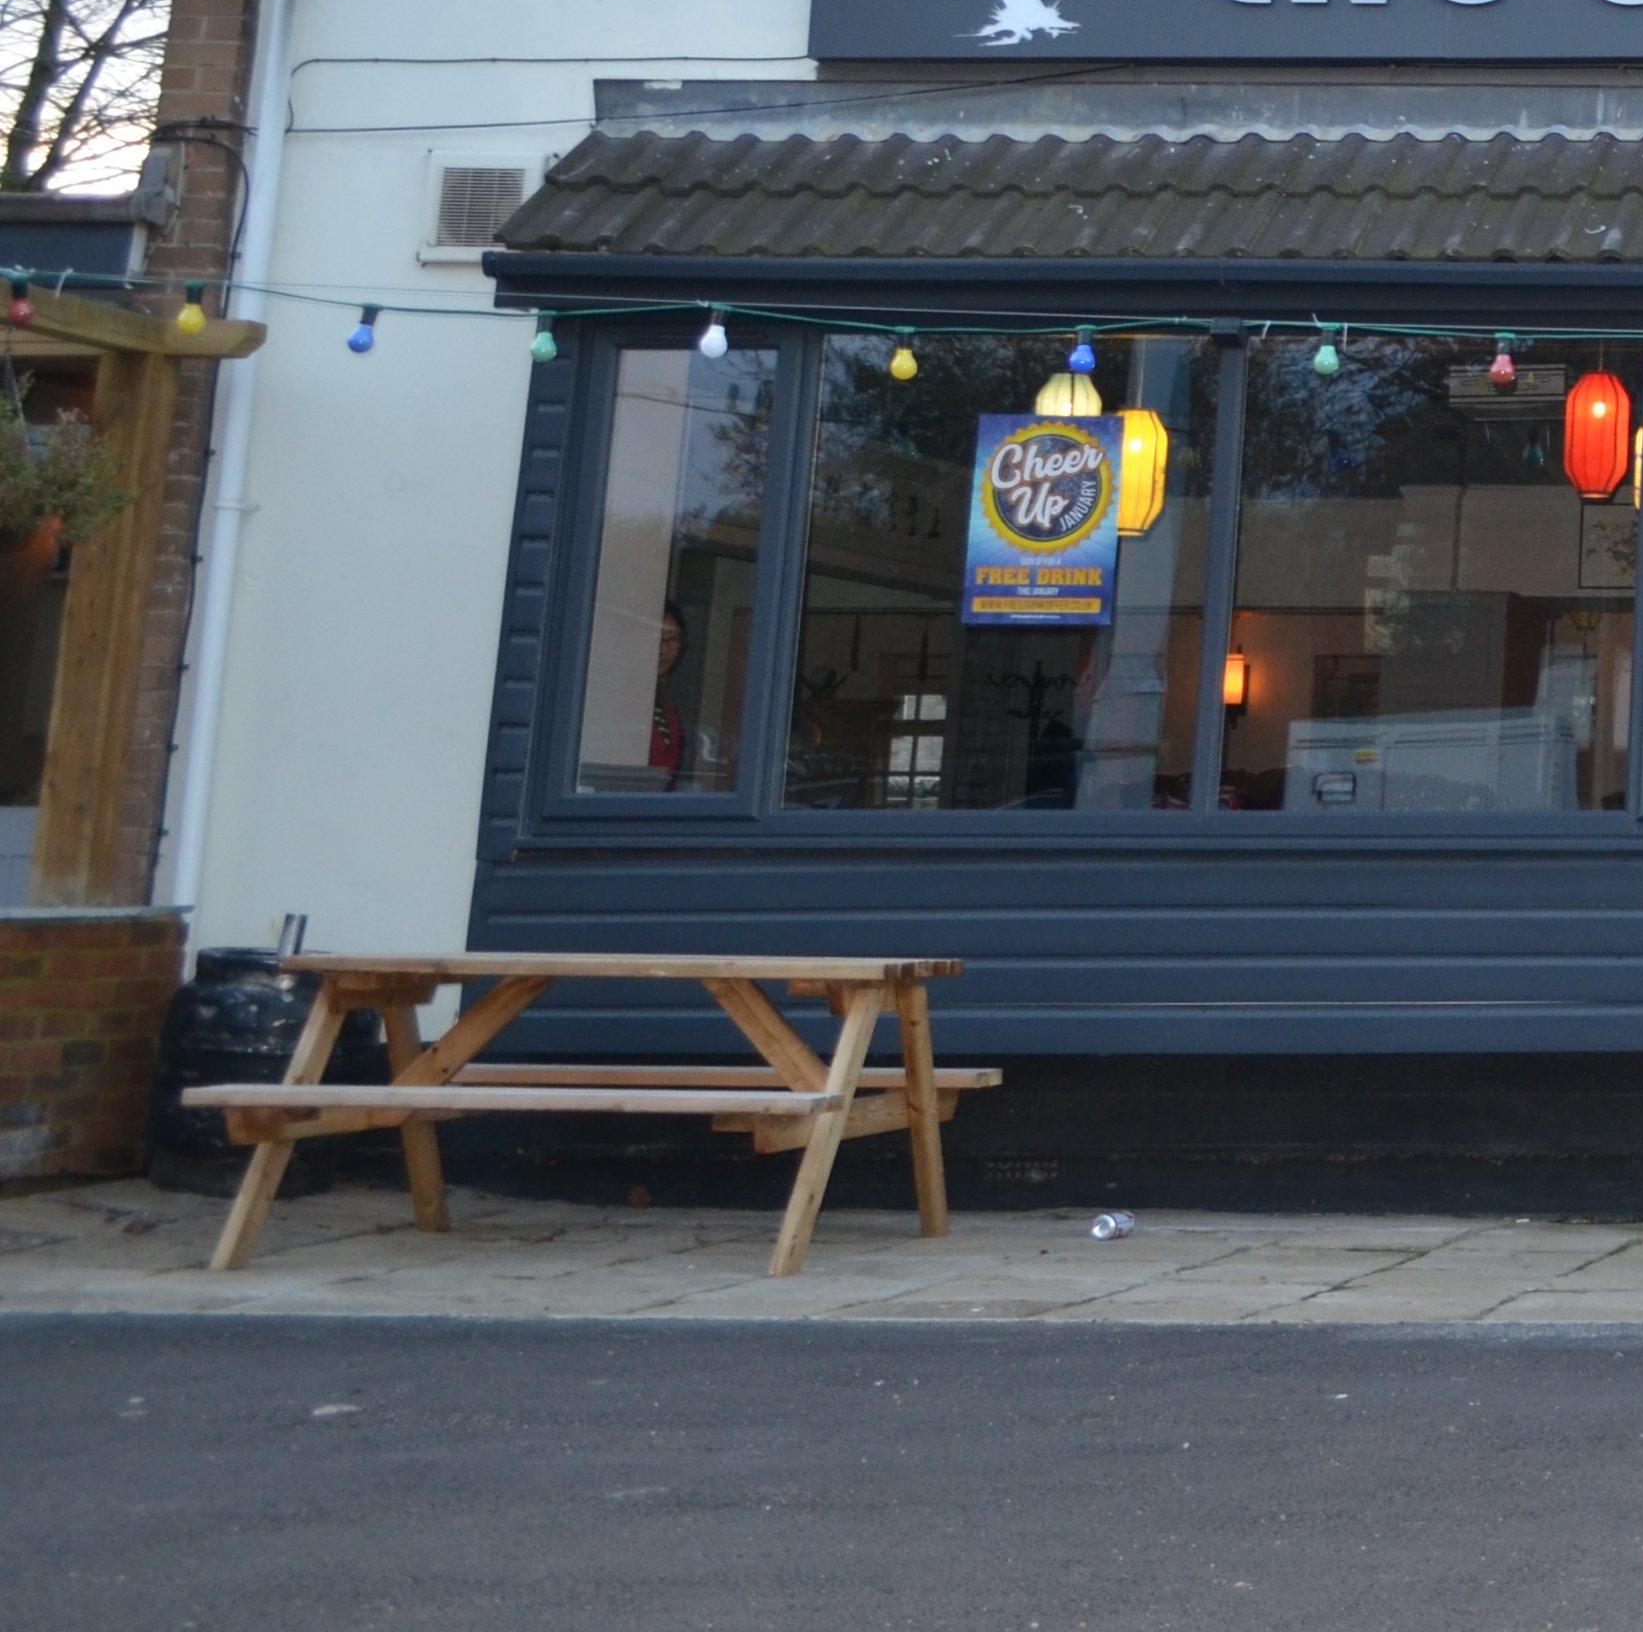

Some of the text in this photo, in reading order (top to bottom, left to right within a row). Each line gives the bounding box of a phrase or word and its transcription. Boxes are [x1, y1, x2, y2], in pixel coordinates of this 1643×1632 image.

[991, 443, 1103, 489] Cheer
[1011, 482, 1069, 528] Up
[1058, 480, 1097, 532] JANUARY
[975, 566, 1102, 586] FREE DRINK
